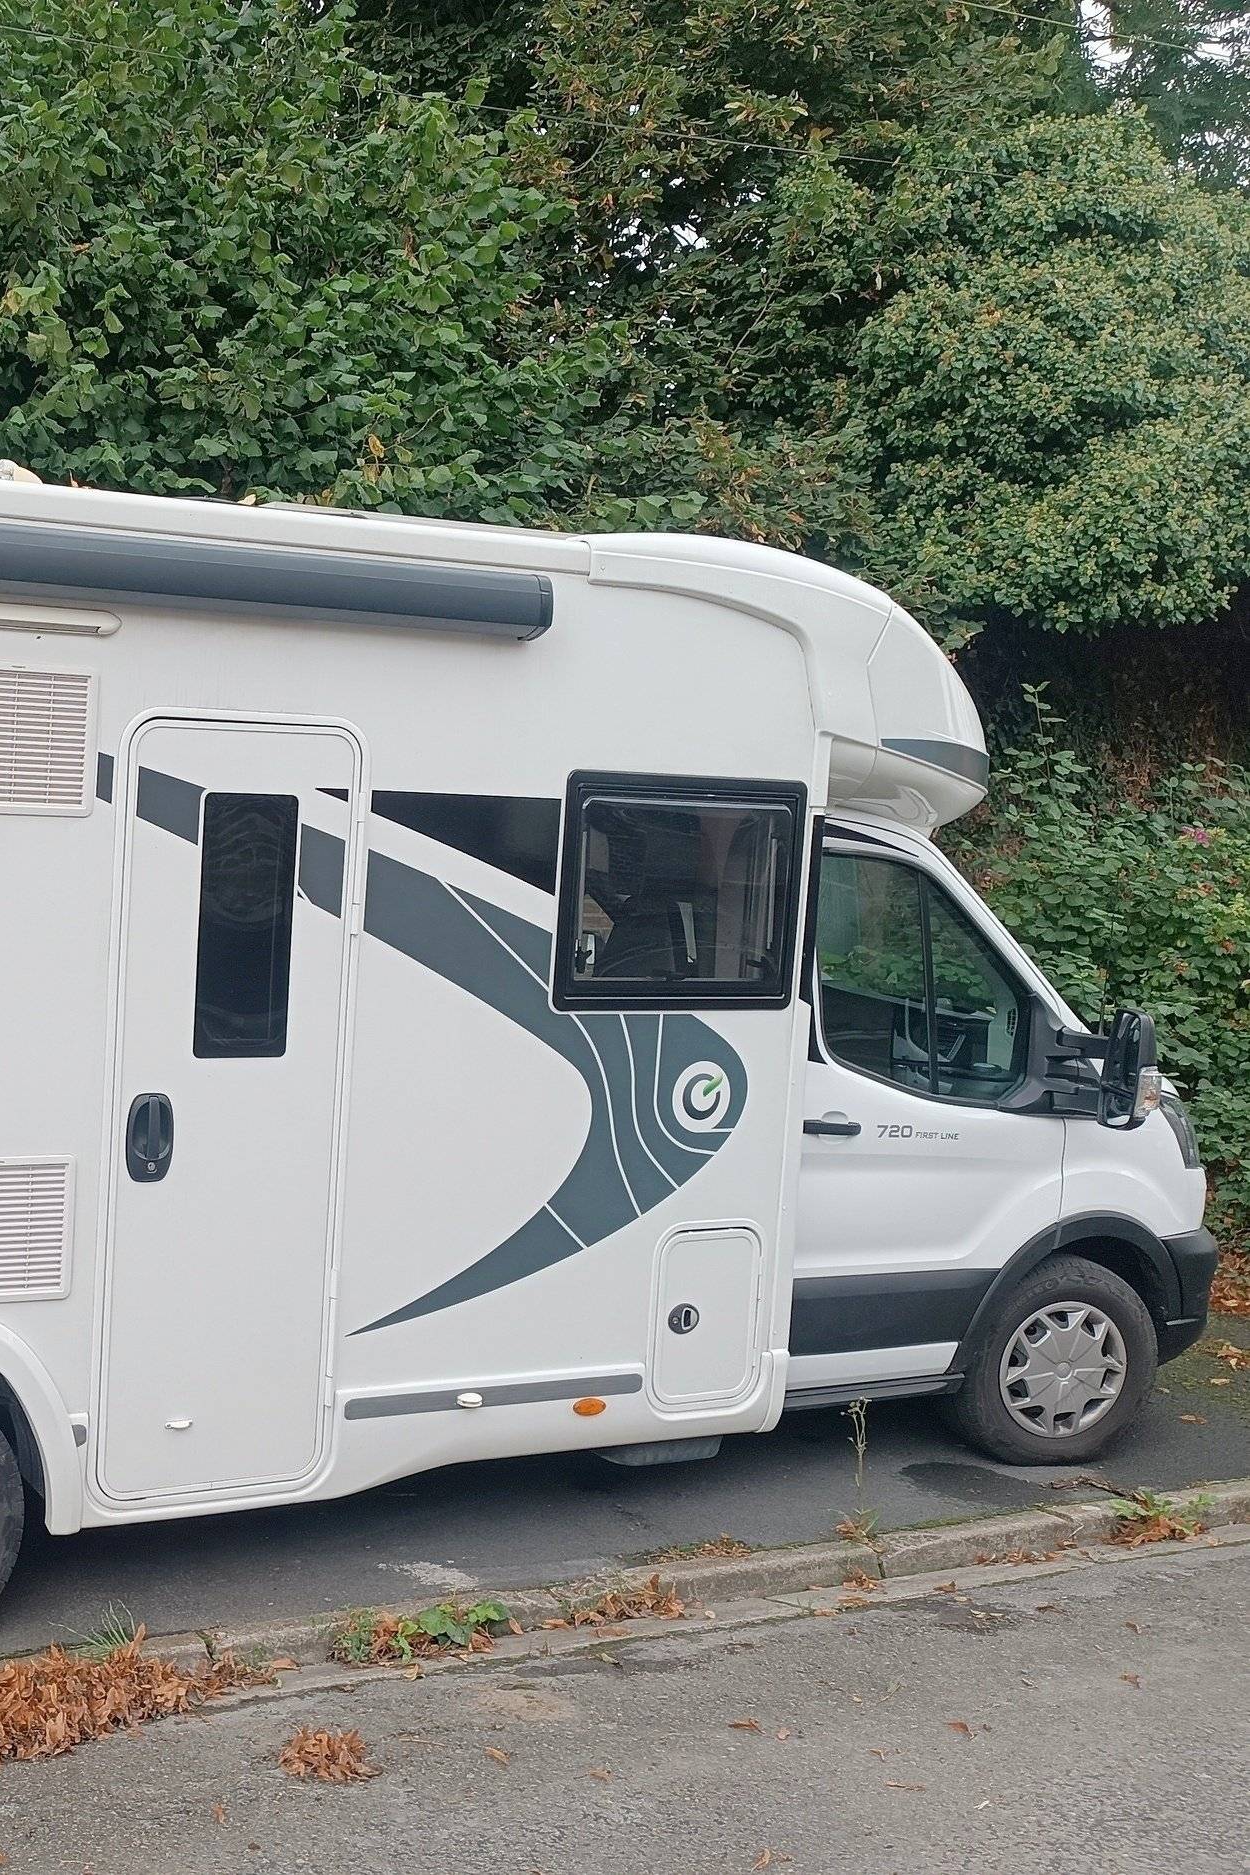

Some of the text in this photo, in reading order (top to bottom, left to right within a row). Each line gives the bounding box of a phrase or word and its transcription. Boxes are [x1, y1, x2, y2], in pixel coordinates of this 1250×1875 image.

[877, 1124, 959, 1141] 720 FIRST LINE
